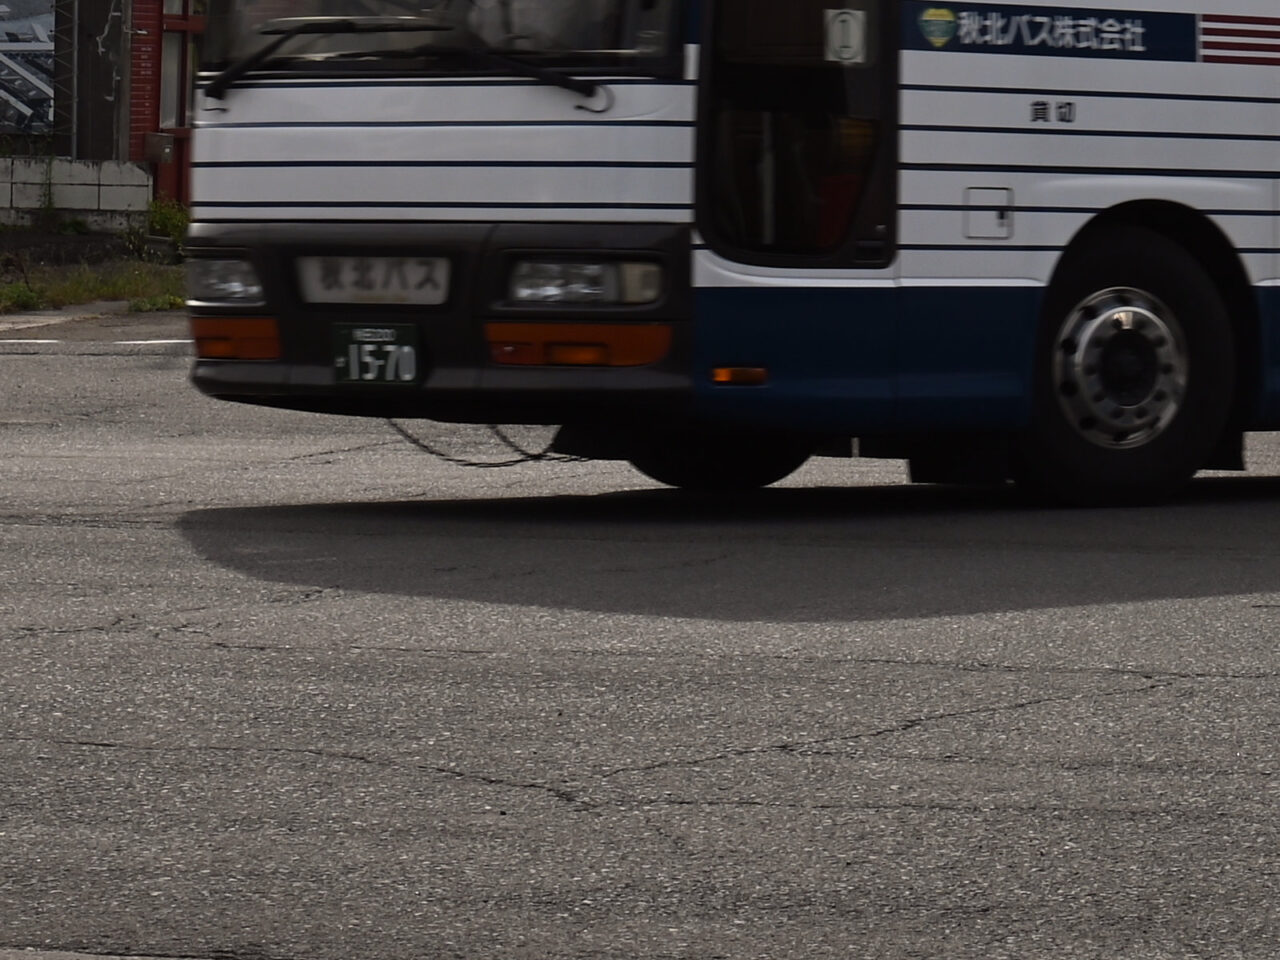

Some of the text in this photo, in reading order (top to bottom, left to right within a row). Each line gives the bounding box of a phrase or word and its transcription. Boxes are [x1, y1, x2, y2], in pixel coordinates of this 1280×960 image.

[957, 11, 1147, 51] 秋北バス株式会社
[349, 344, 416, 380] 15-70
